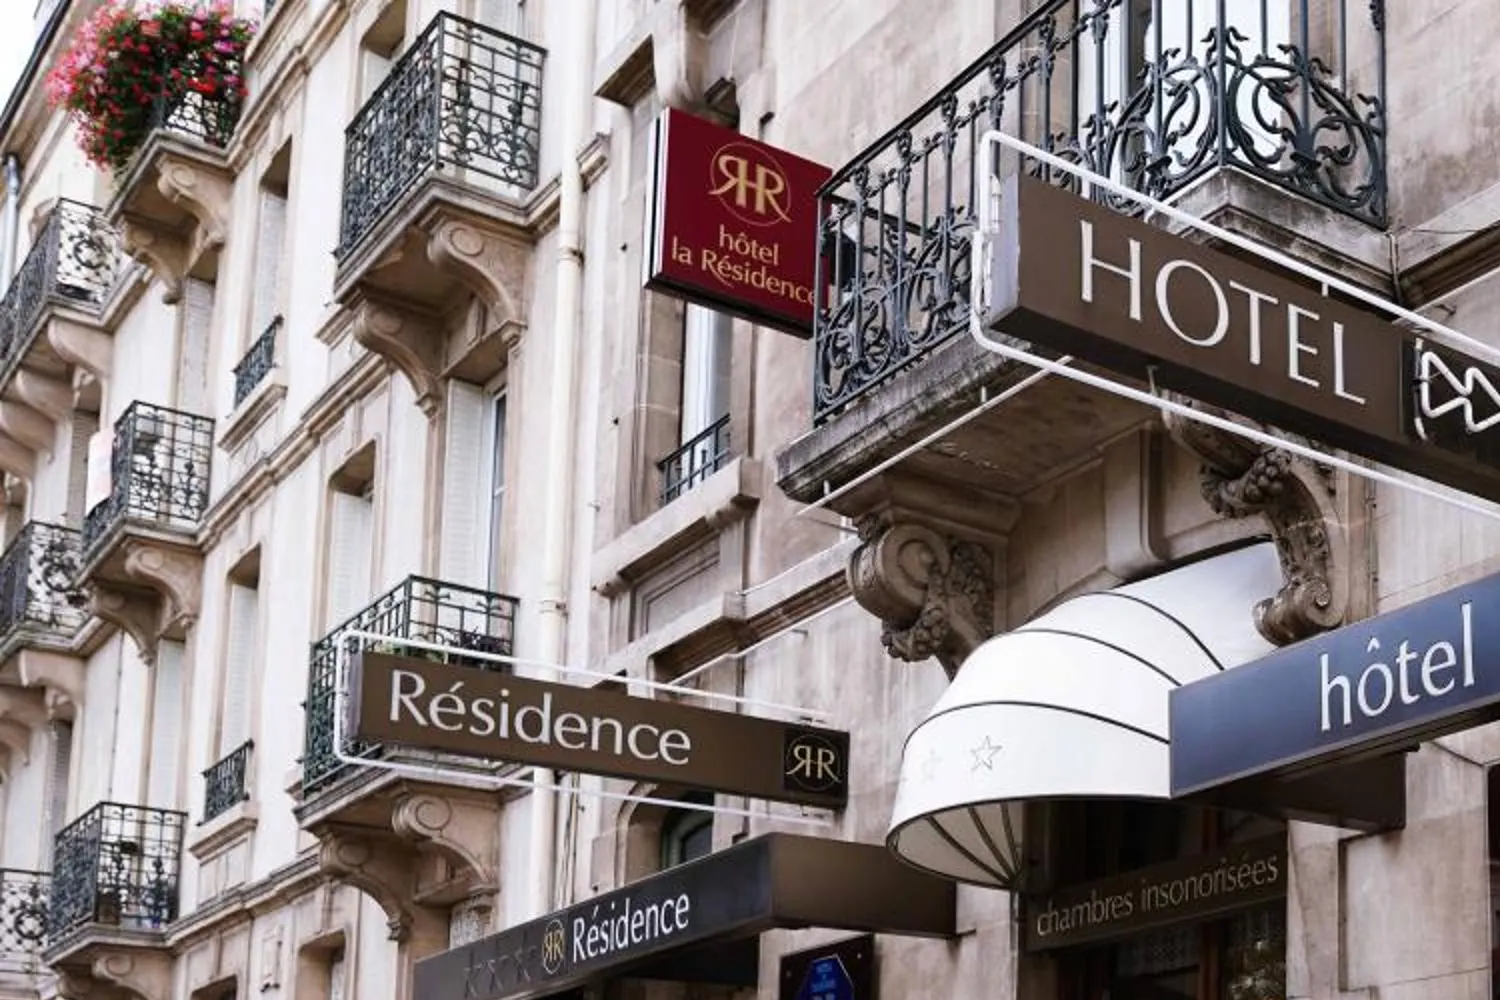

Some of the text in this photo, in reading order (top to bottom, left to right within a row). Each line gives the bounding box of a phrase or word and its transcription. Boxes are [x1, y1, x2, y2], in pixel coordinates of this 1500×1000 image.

[672, 237, 692, 266] la
[719, 223, 780, 266] hôtel
[1080, 220, 1367, 405] HOTEL
[1320, 600, 1475, 732] hôtel
[389, 668, 693, 766] Résidence
[572, 892, 690, 963] Résidence
[1037, 853, 1279, 937] chambres insonorisées
